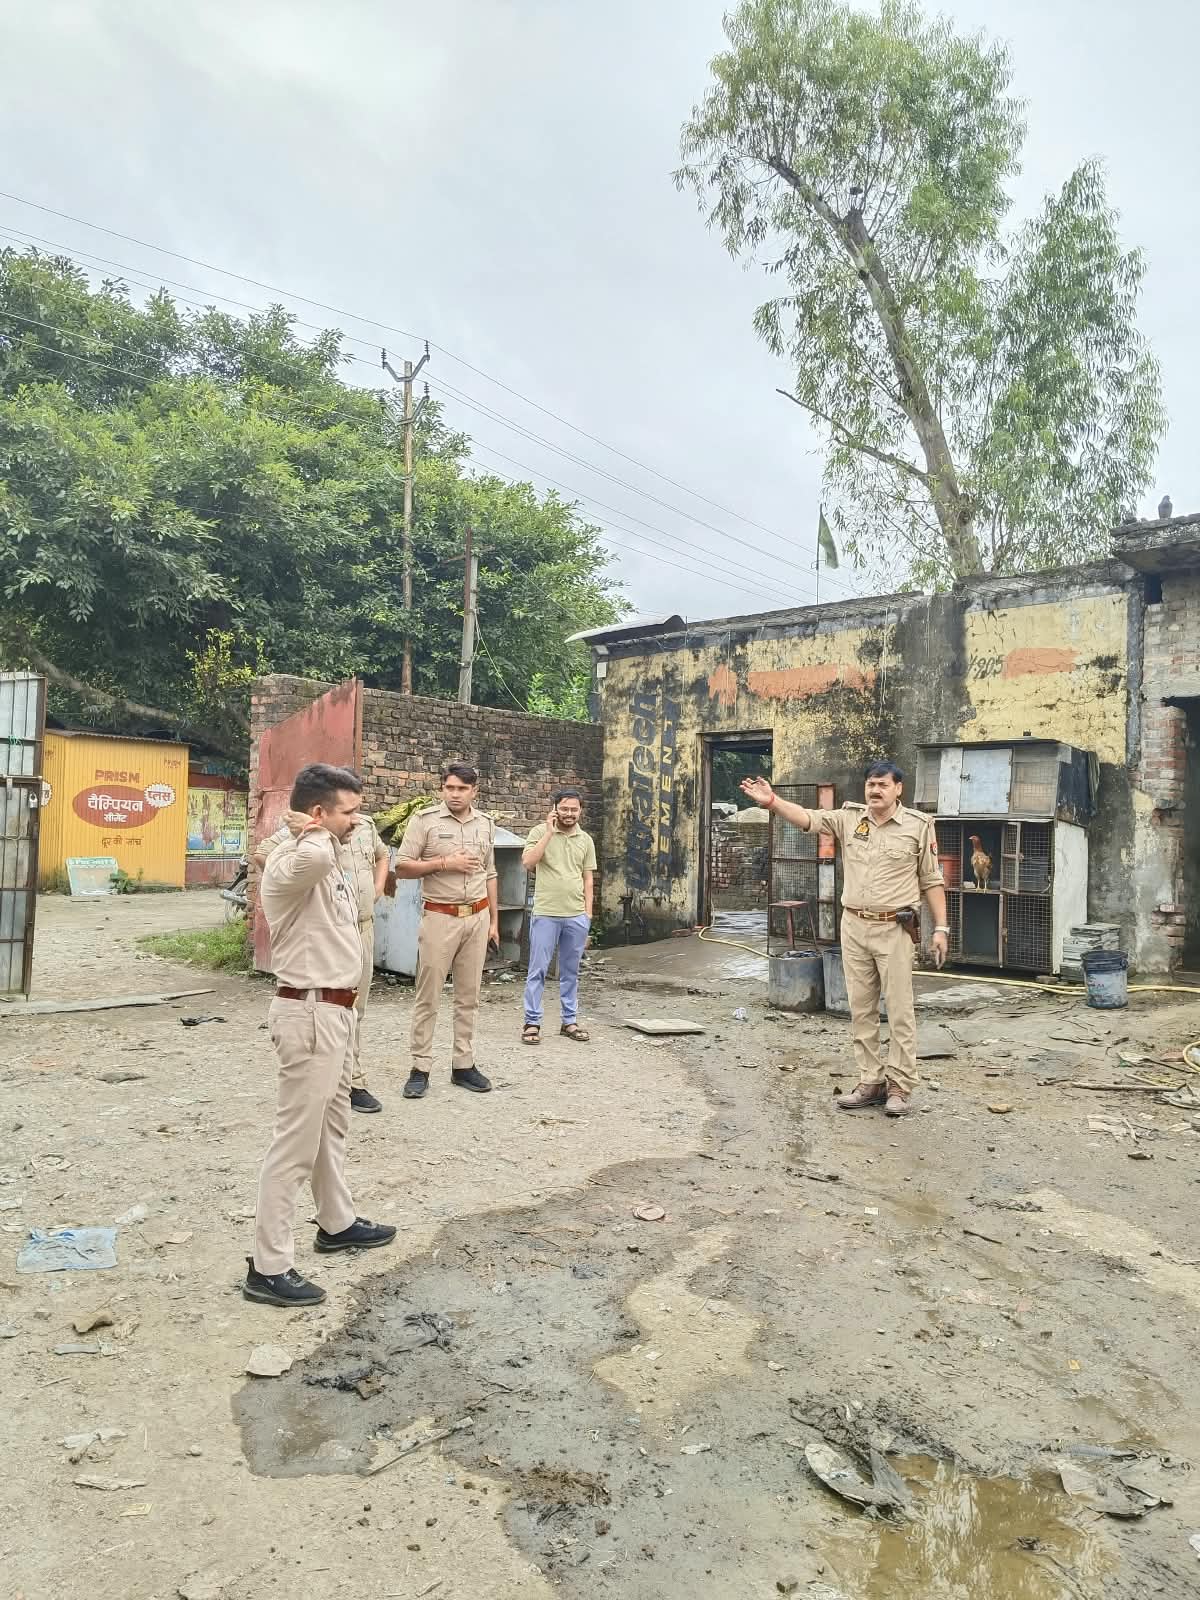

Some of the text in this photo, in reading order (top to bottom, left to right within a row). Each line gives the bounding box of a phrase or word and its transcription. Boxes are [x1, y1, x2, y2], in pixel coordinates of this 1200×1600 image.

[95, 770, 140, 784] PRISM
[87, 793, 144, 812] चैम्पियन
[148, 790, 172, 802] प्लस
